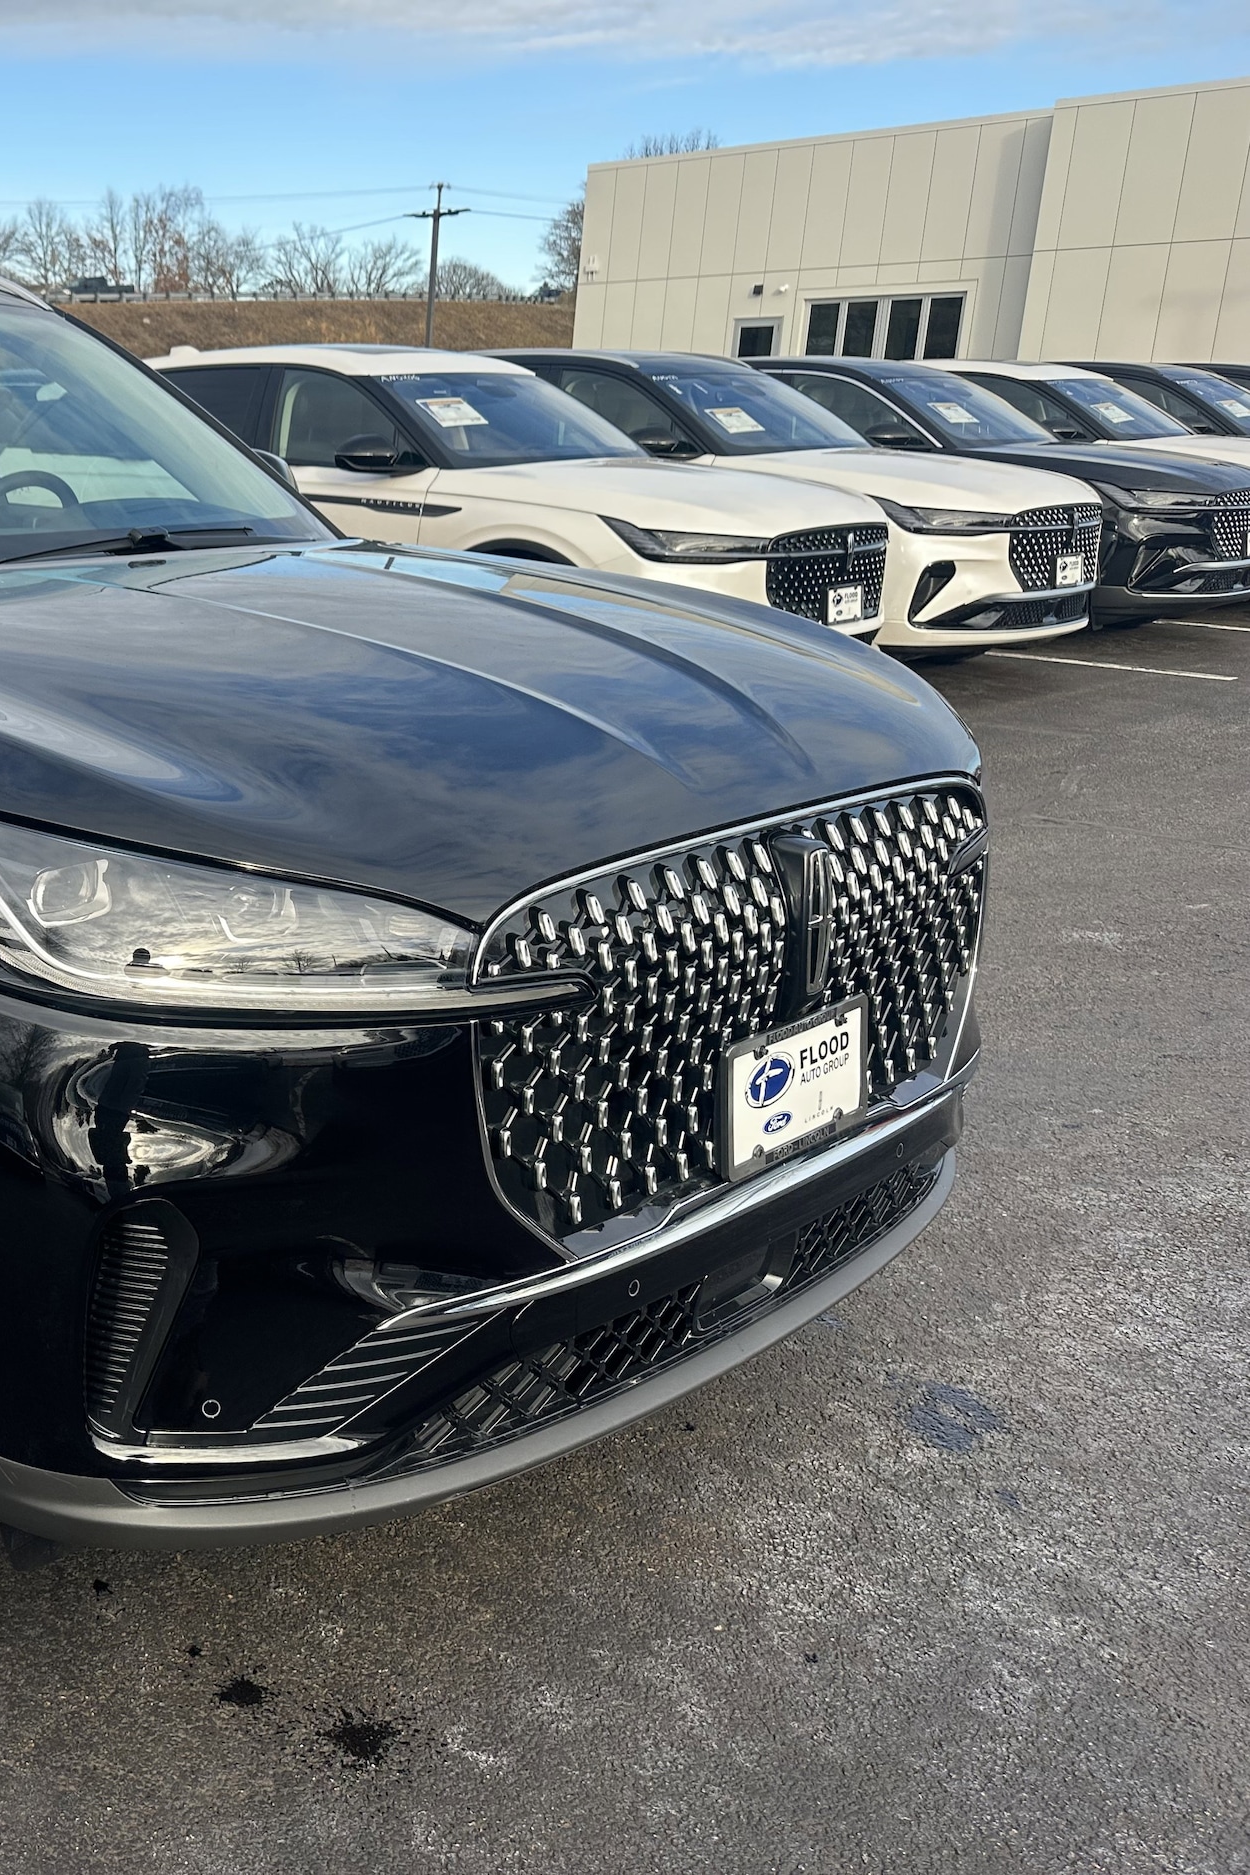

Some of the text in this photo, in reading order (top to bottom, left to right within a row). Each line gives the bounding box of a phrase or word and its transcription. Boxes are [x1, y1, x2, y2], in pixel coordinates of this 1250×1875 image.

[799, 1031, 850, 1069] FLOOD
[800, 1052, 850, 1086] AUTO GROUP
